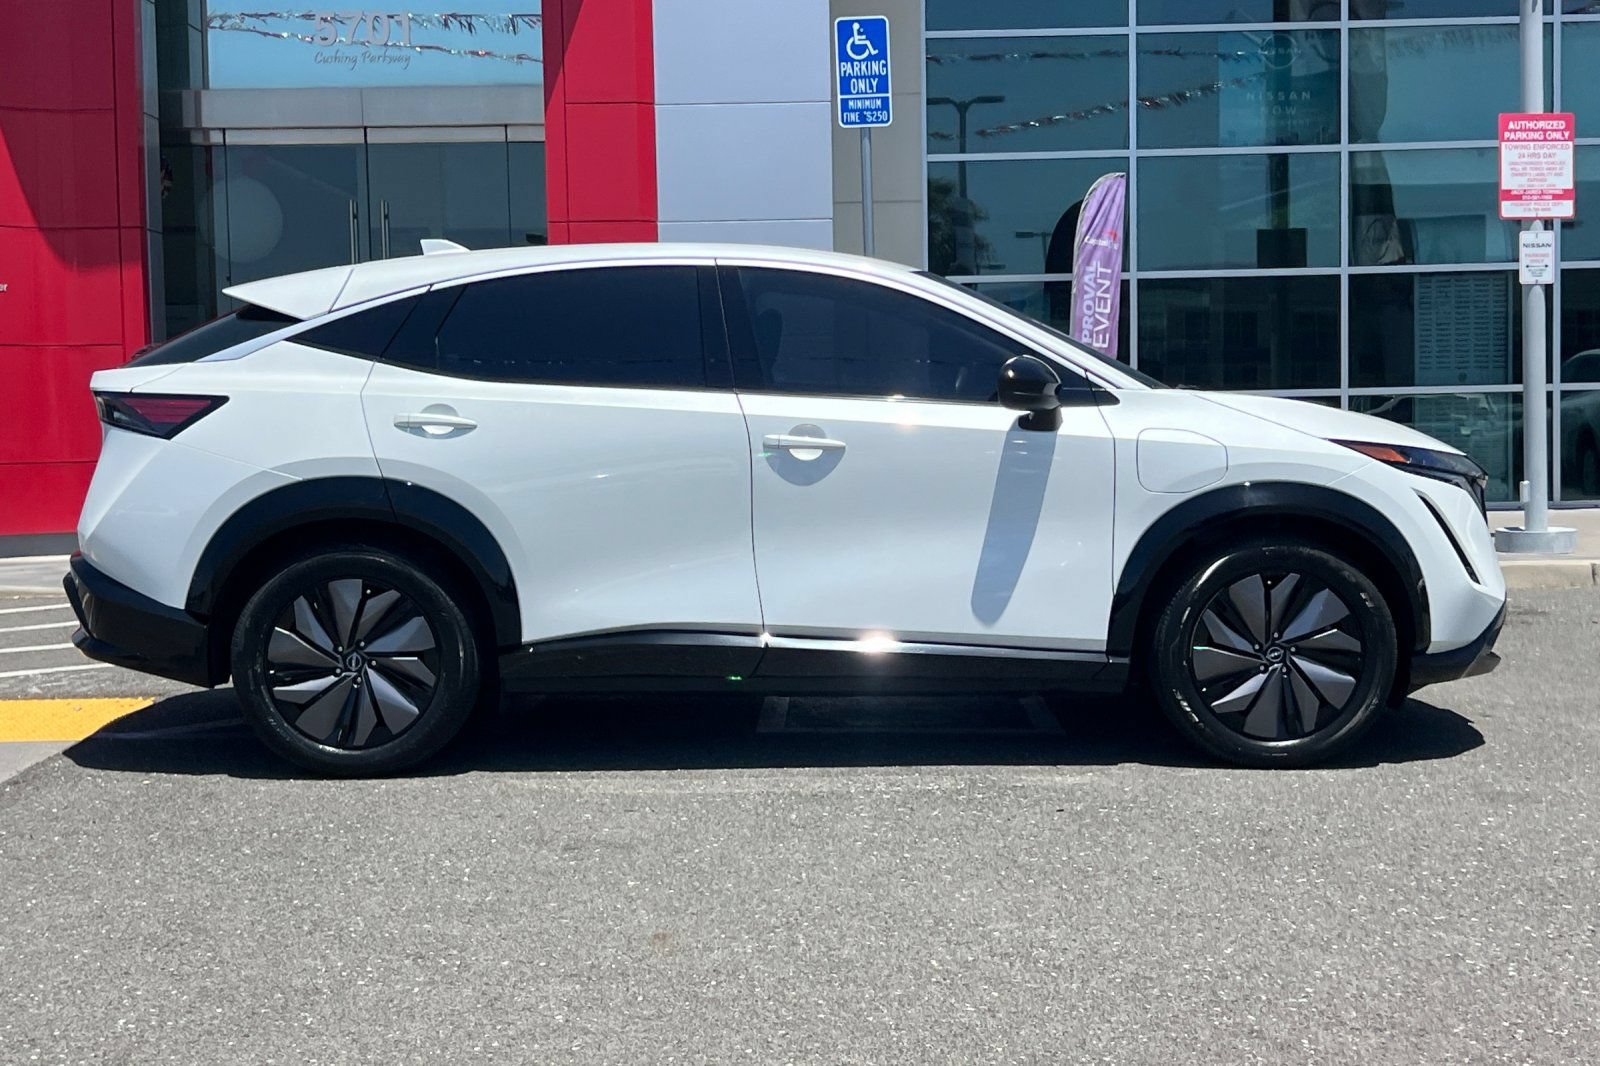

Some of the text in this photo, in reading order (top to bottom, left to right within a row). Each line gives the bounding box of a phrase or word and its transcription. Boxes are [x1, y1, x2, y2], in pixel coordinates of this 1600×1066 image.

[313, 10, 411, 47] 5701
[314, 48, 411, 70] Cushing Parkway
[840, 60, 887, 77] PARKING
[850, 78, 878, 94] ONLY
[1246, 91, 1311, 101] NISSAN
[848, 98, 882, 110] MINIMUM
[843, 112, 860, 123] FINE
[1508, 120, 1566, 130] AUTHORIZED
[1504, 131, 1570, 140] PARKING ONLY
[1092, 261, 1112, 349] EVENT
